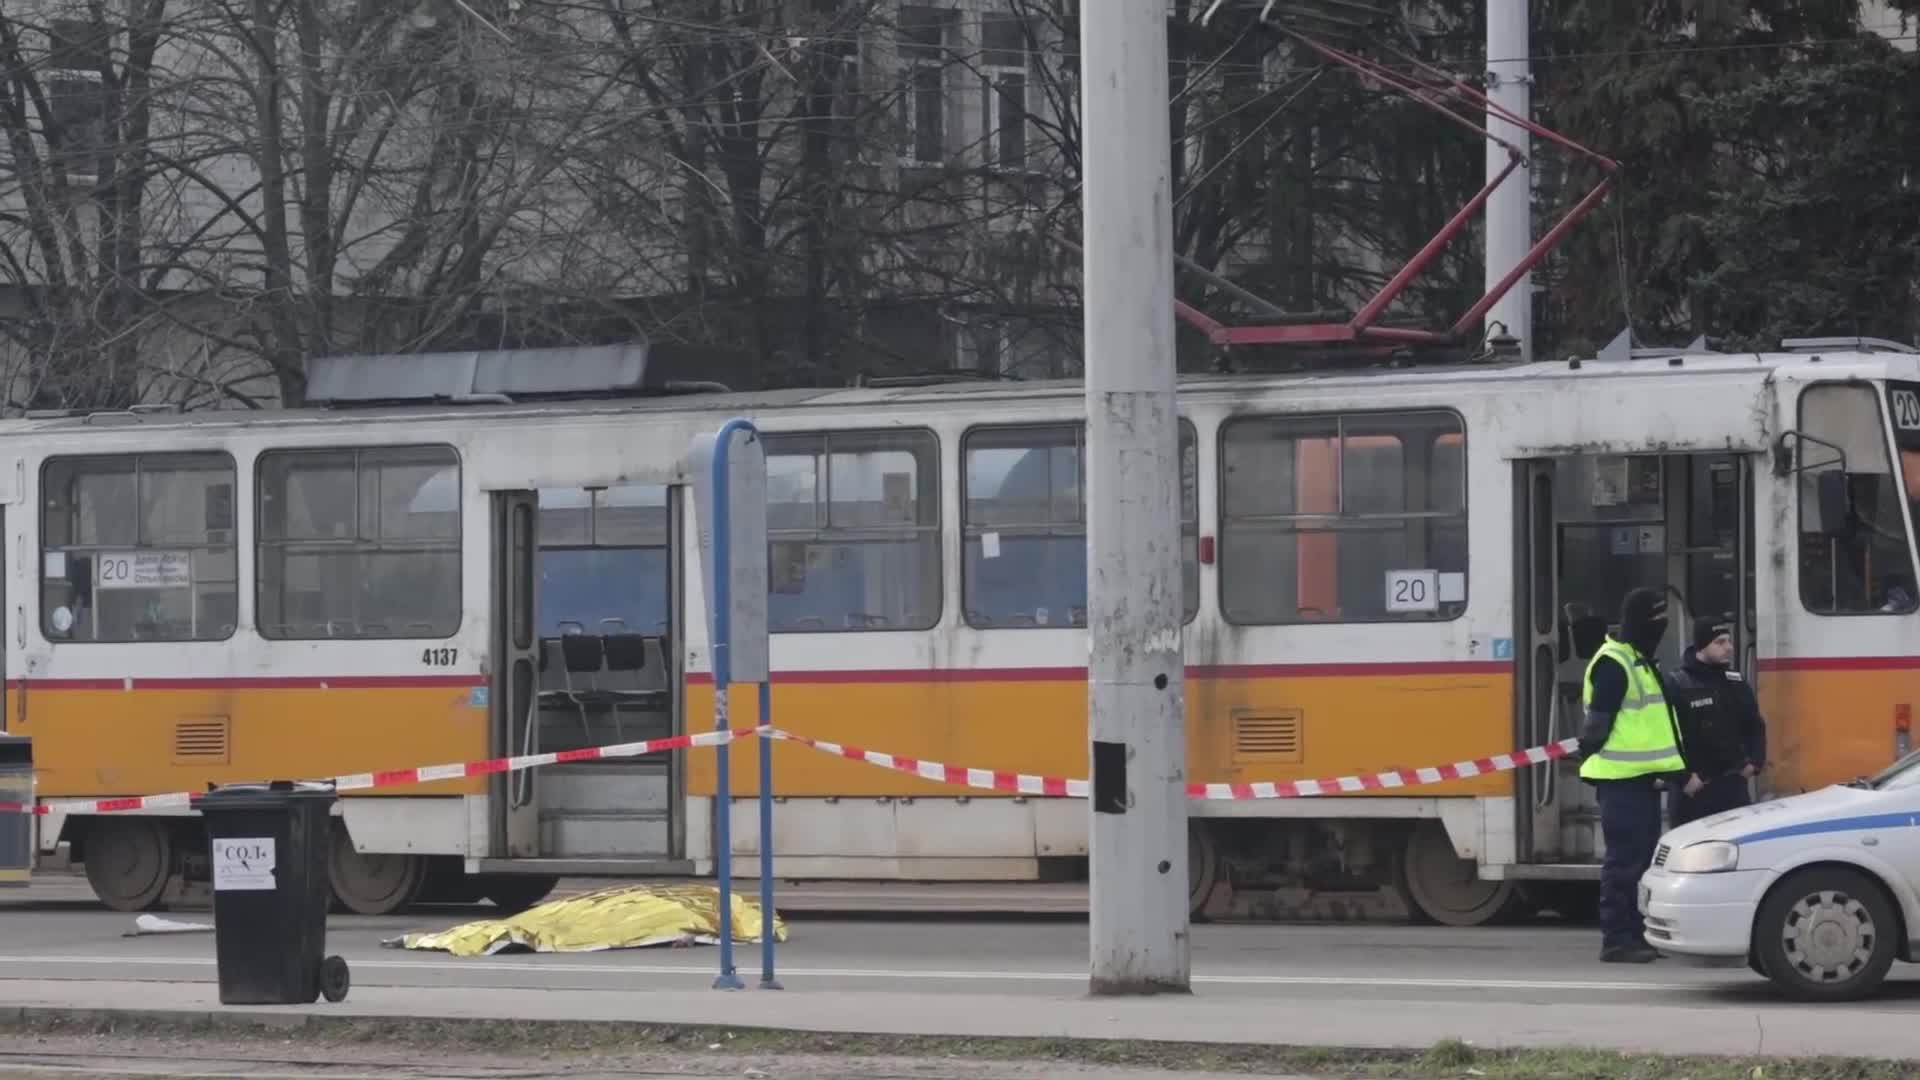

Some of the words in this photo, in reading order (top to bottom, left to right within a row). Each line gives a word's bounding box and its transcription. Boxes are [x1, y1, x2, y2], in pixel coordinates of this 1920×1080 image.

[1896, 392, 1920, 427] 20
[103, 559, 129, 580] 20
[1395, 579, 1425, 603] 20
[422, 648, 458, 666] 4137
